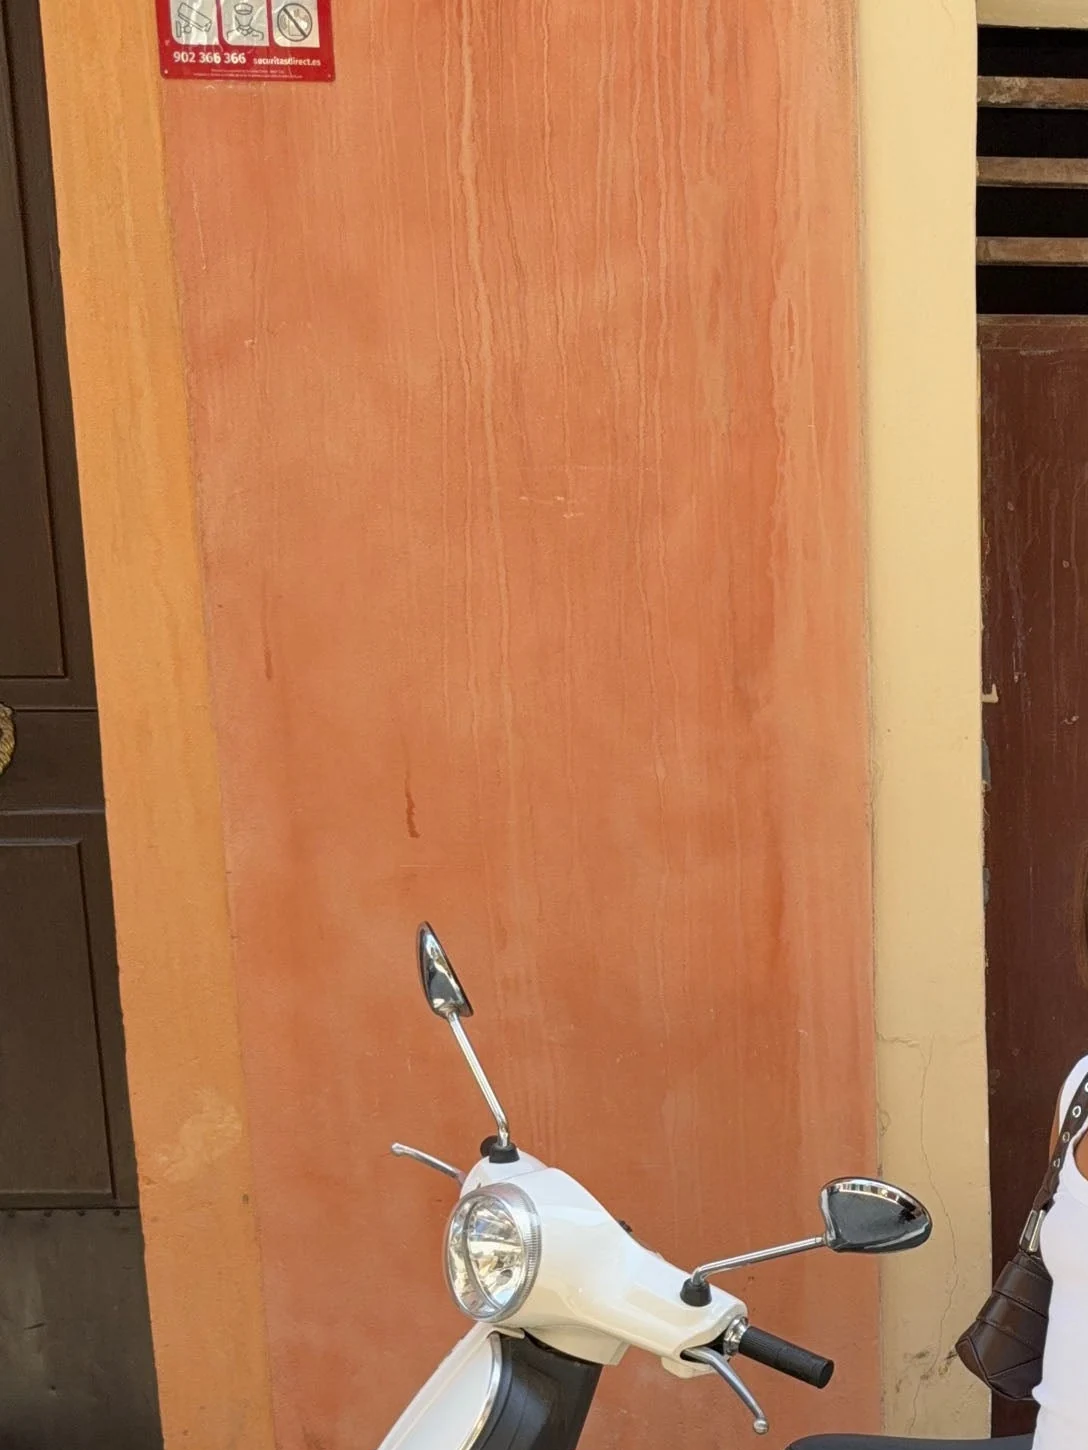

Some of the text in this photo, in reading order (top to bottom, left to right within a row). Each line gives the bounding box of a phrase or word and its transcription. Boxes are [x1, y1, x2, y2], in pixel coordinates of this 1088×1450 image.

[173, 51, 246, 64] 902 366 366
[253, 56, 321, 66] securitasdirect.es
